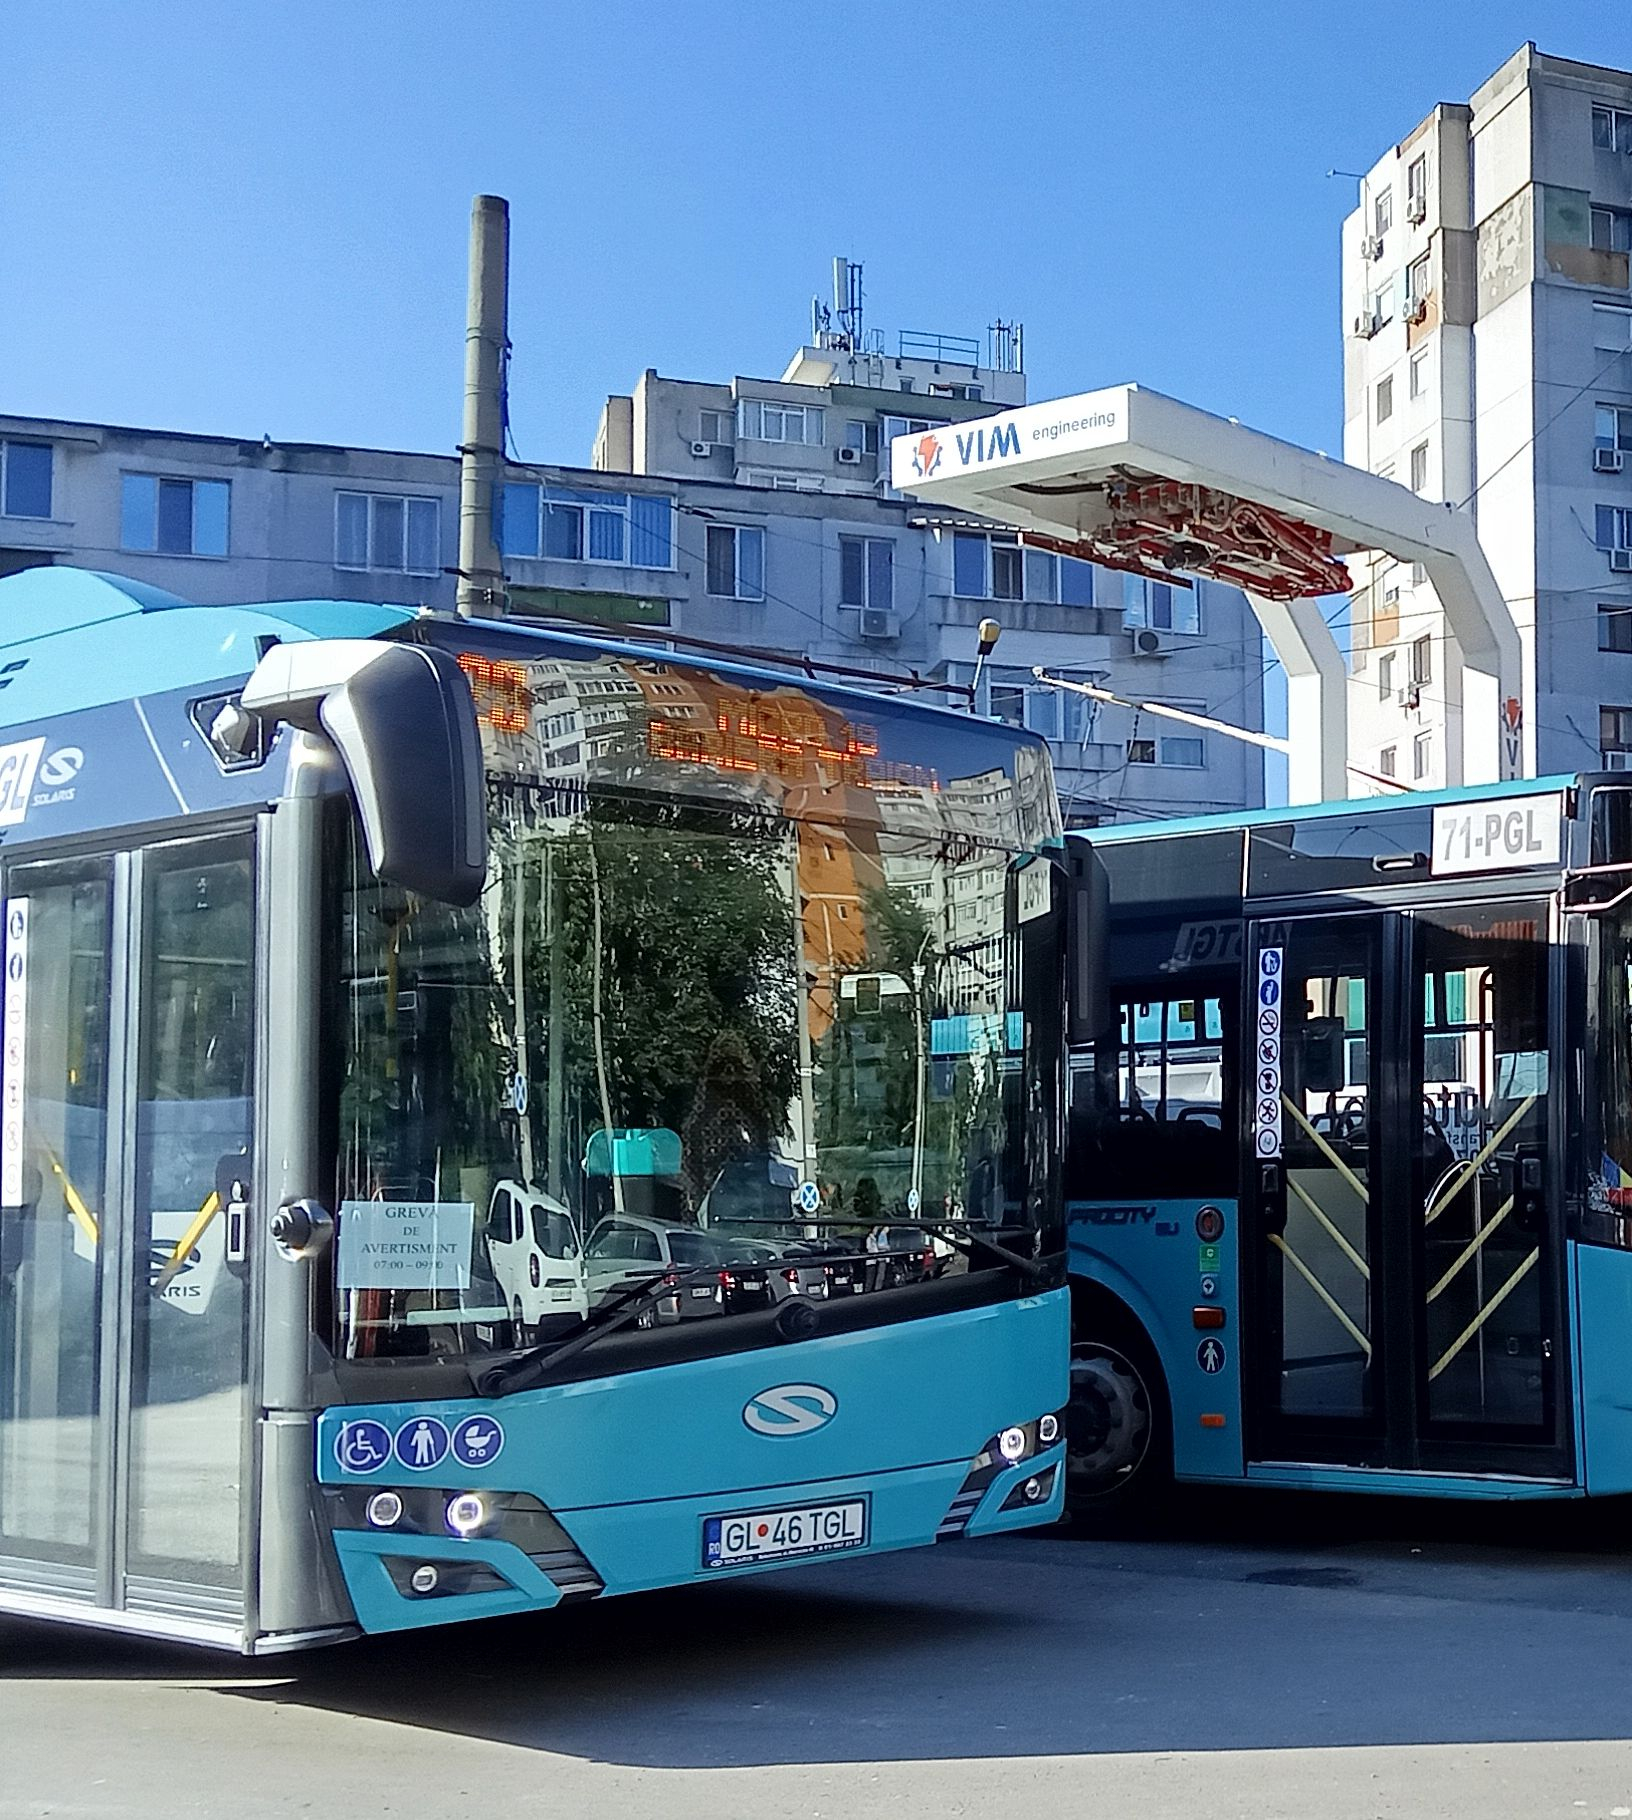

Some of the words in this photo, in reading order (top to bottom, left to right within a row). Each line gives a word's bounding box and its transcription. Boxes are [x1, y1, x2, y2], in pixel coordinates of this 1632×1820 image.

[956, 423, 1021, 465] VIM
[1032, 411, 1115, 440] engineering
[1442, 809, 1542, 861] 71-PGL
[403, 1226, 420, 1236] DE
[708, 1542, 720, 1556] RO
[726, 1522, 760, 1552] GL
[772, 1515, 802, 1546] 46
[809, 1509, 855, 1541] TGL
